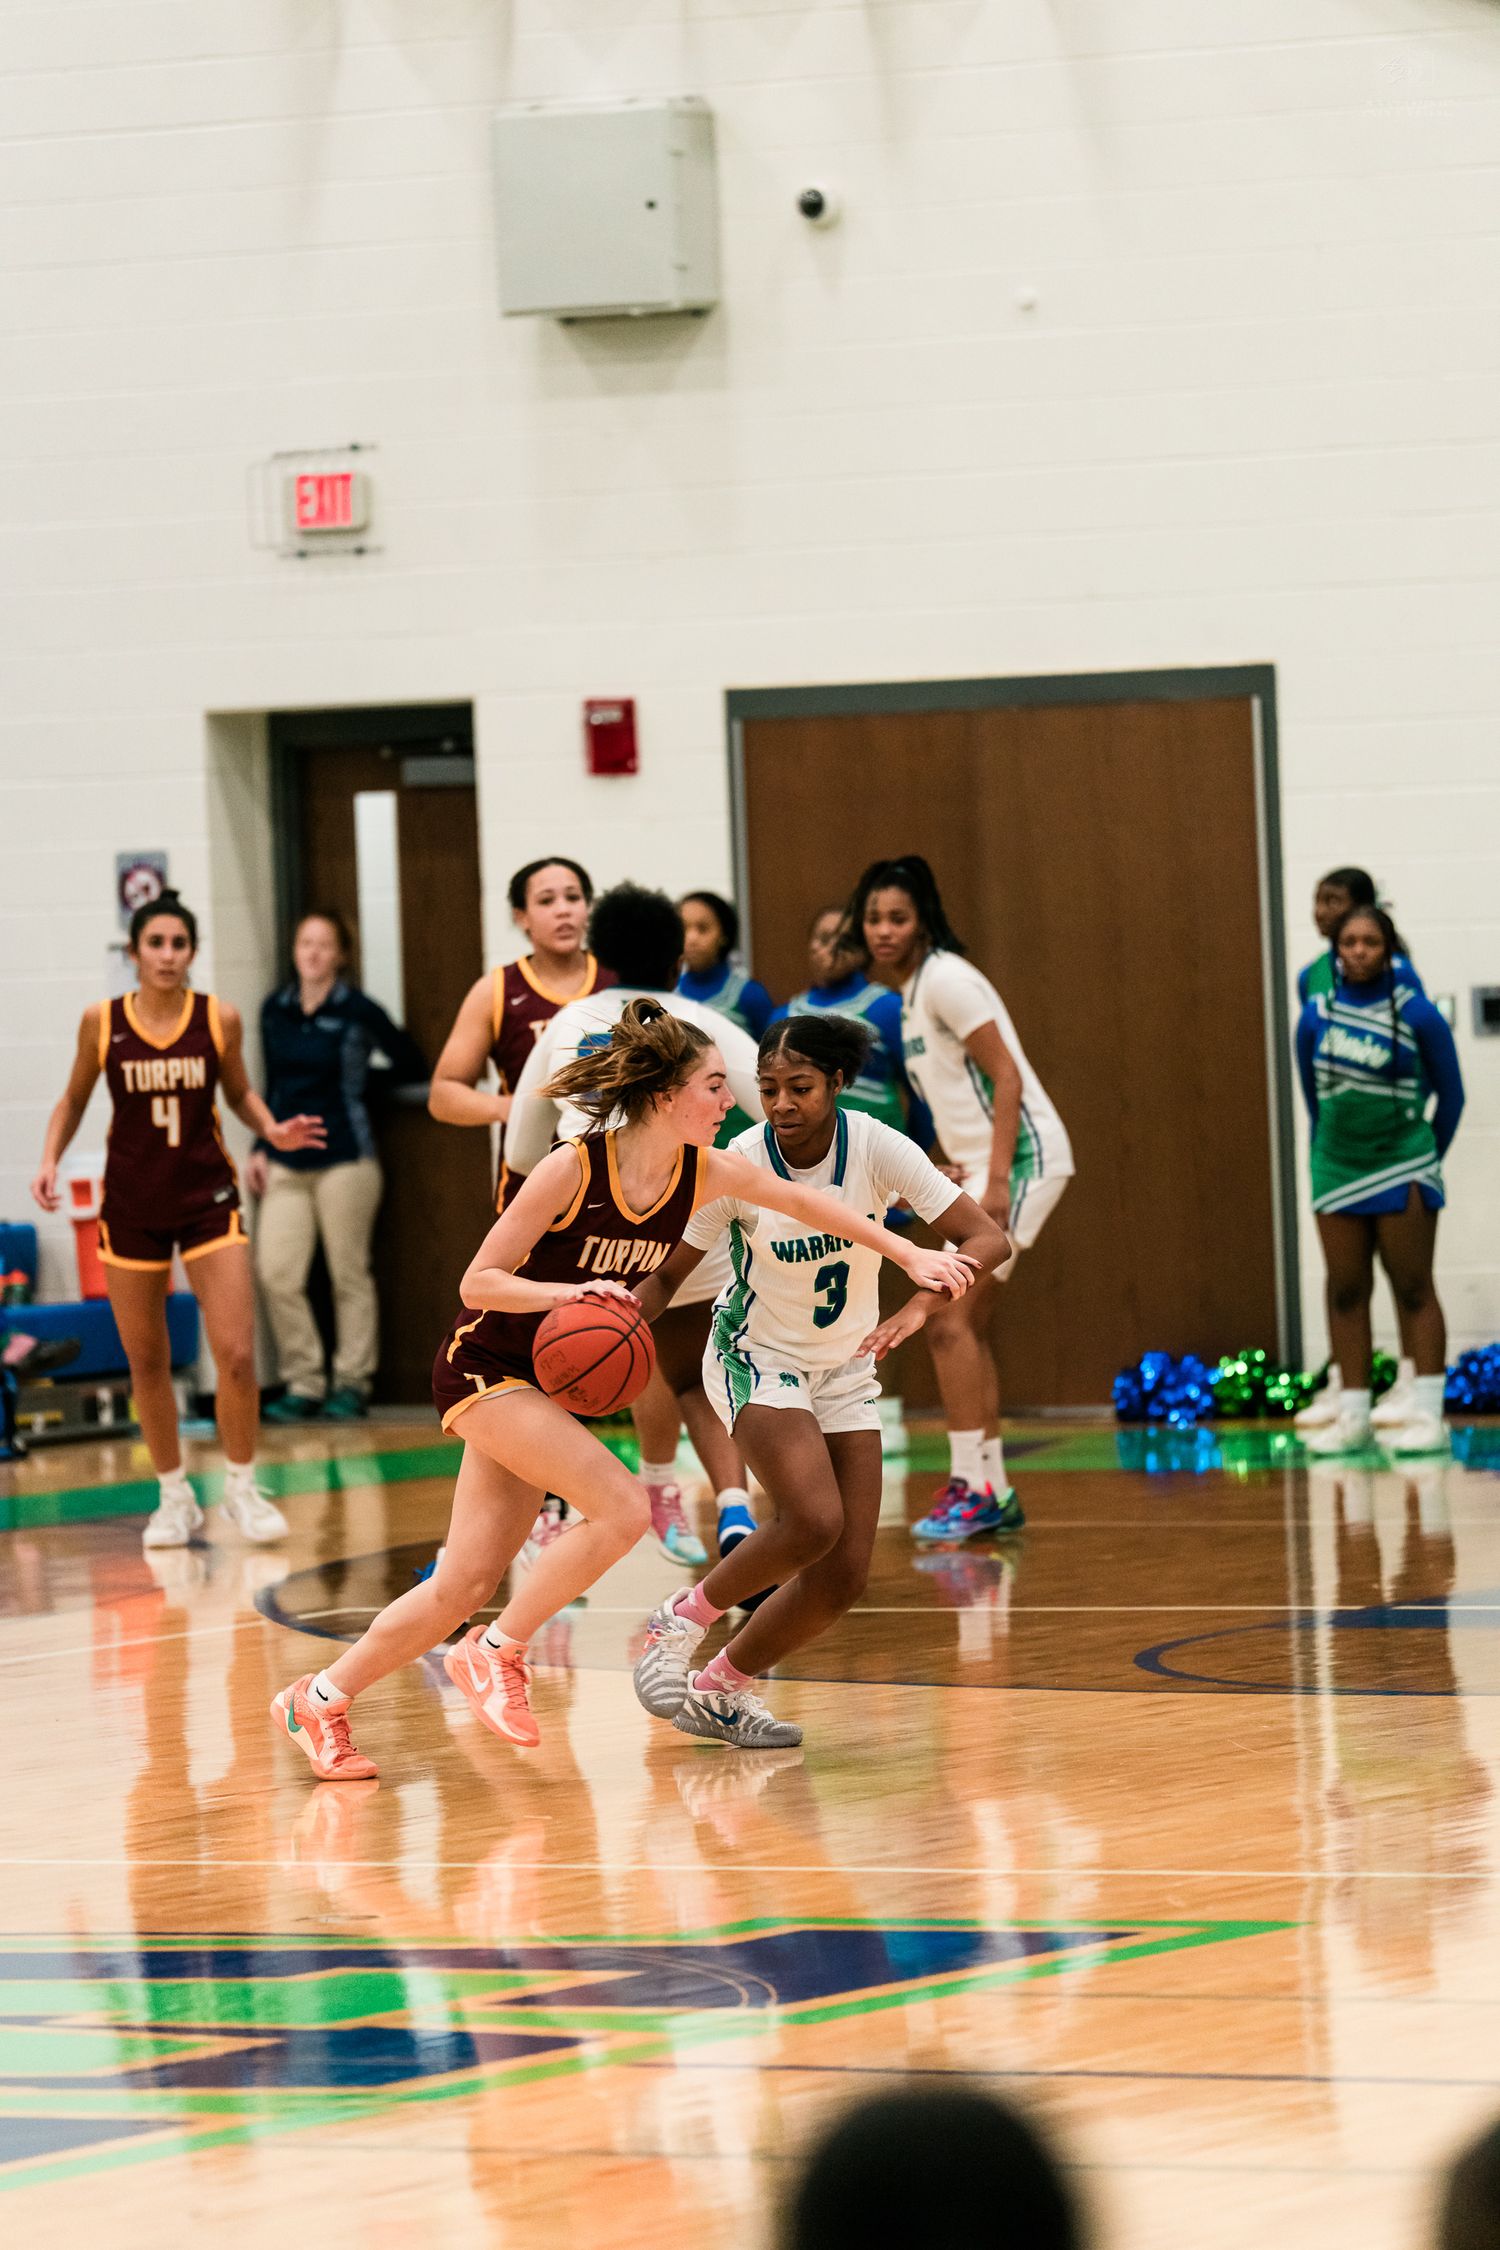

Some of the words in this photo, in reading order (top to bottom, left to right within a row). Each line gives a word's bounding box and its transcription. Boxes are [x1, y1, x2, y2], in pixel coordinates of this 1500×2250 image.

[295, 471, 353, 528] EXIT
[120, 1055, 206, 1093] TURPIN
[151, 1095, 181, 1148] 4
[576, 1235, 671, 1275] TURPIN
[812, 1260, 851, 1330] 3
